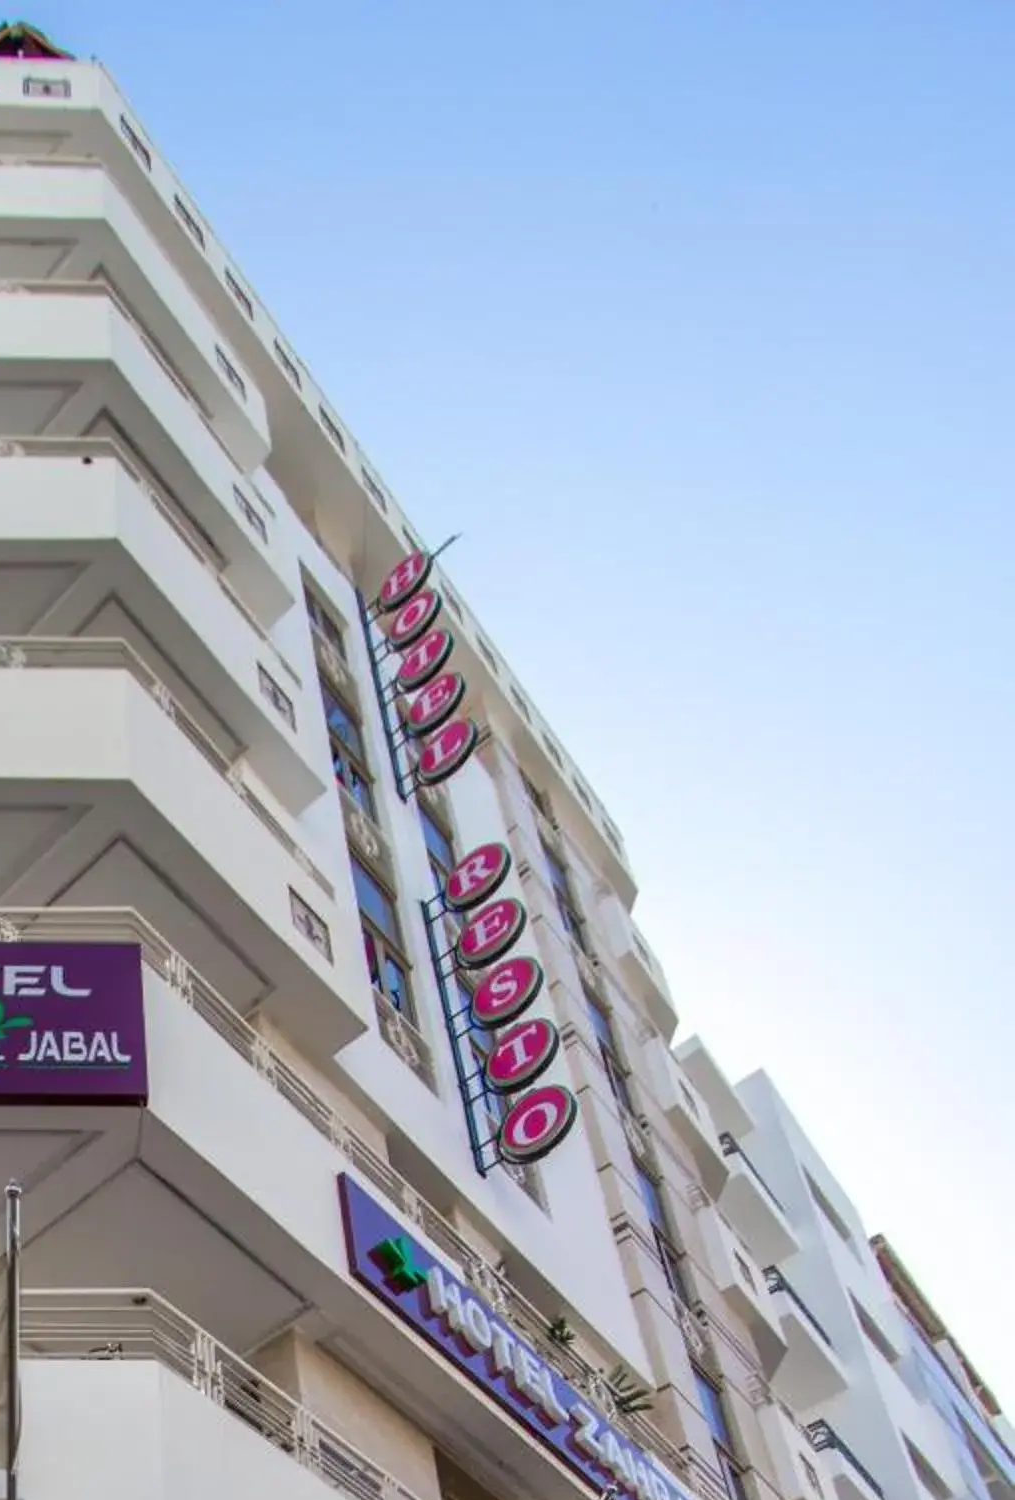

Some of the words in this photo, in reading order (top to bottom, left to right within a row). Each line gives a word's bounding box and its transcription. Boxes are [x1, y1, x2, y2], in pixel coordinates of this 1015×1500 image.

[387, 555, 464, 774] HOTEL
[17, 1031, 131, 1062] JABAL
[455, 854, 558, 1146] RESTO
[423, 1265, 569, 1426] HOTEL
